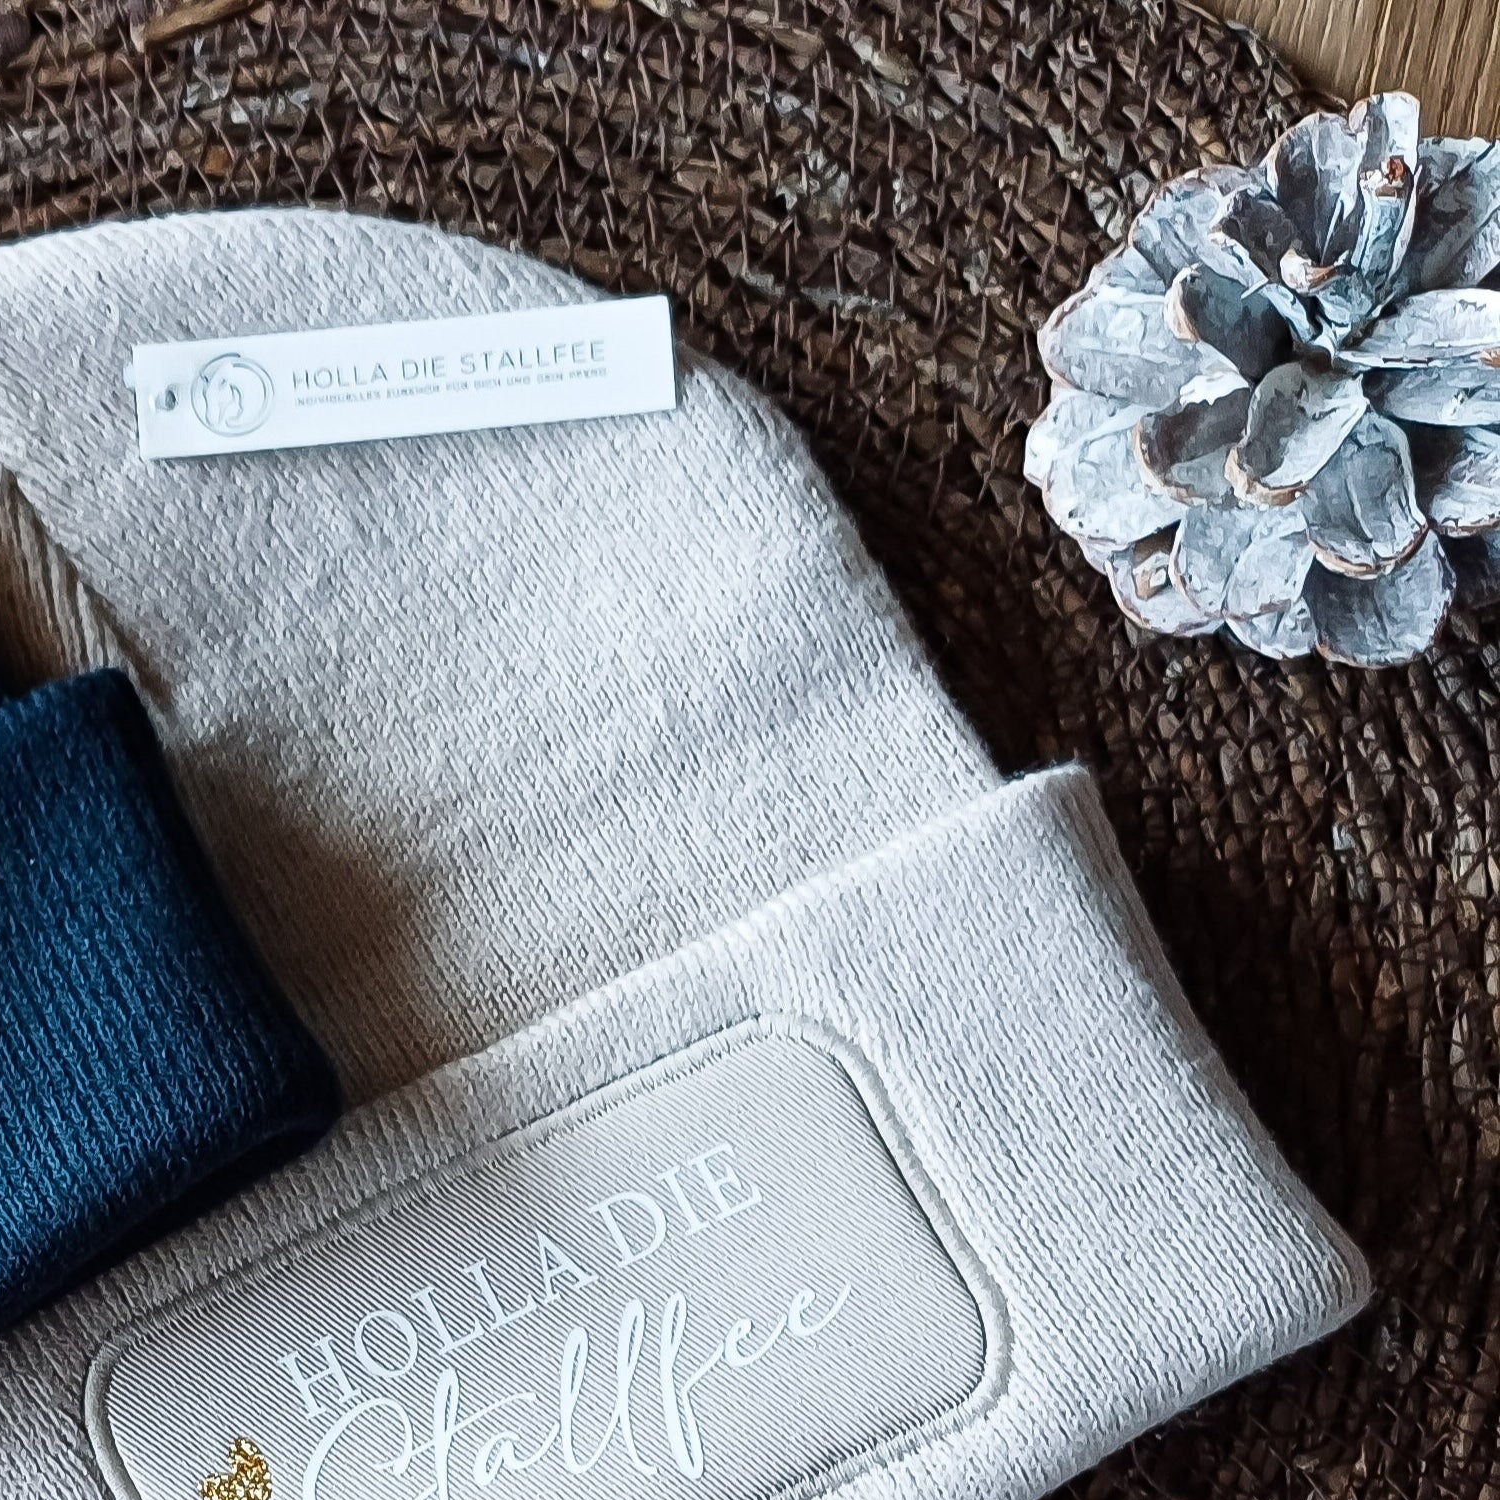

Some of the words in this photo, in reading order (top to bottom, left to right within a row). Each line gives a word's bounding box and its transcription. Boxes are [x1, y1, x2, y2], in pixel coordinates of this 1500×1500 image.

[292, 362, 389, 390] HOLLA
[401, 355, 447, 381] DIE
[460, 339, 606, 375] STALLFEE
[277, 1231, 598, 1419] HOLLA
[588, 1141, 764, 1269] DIE
